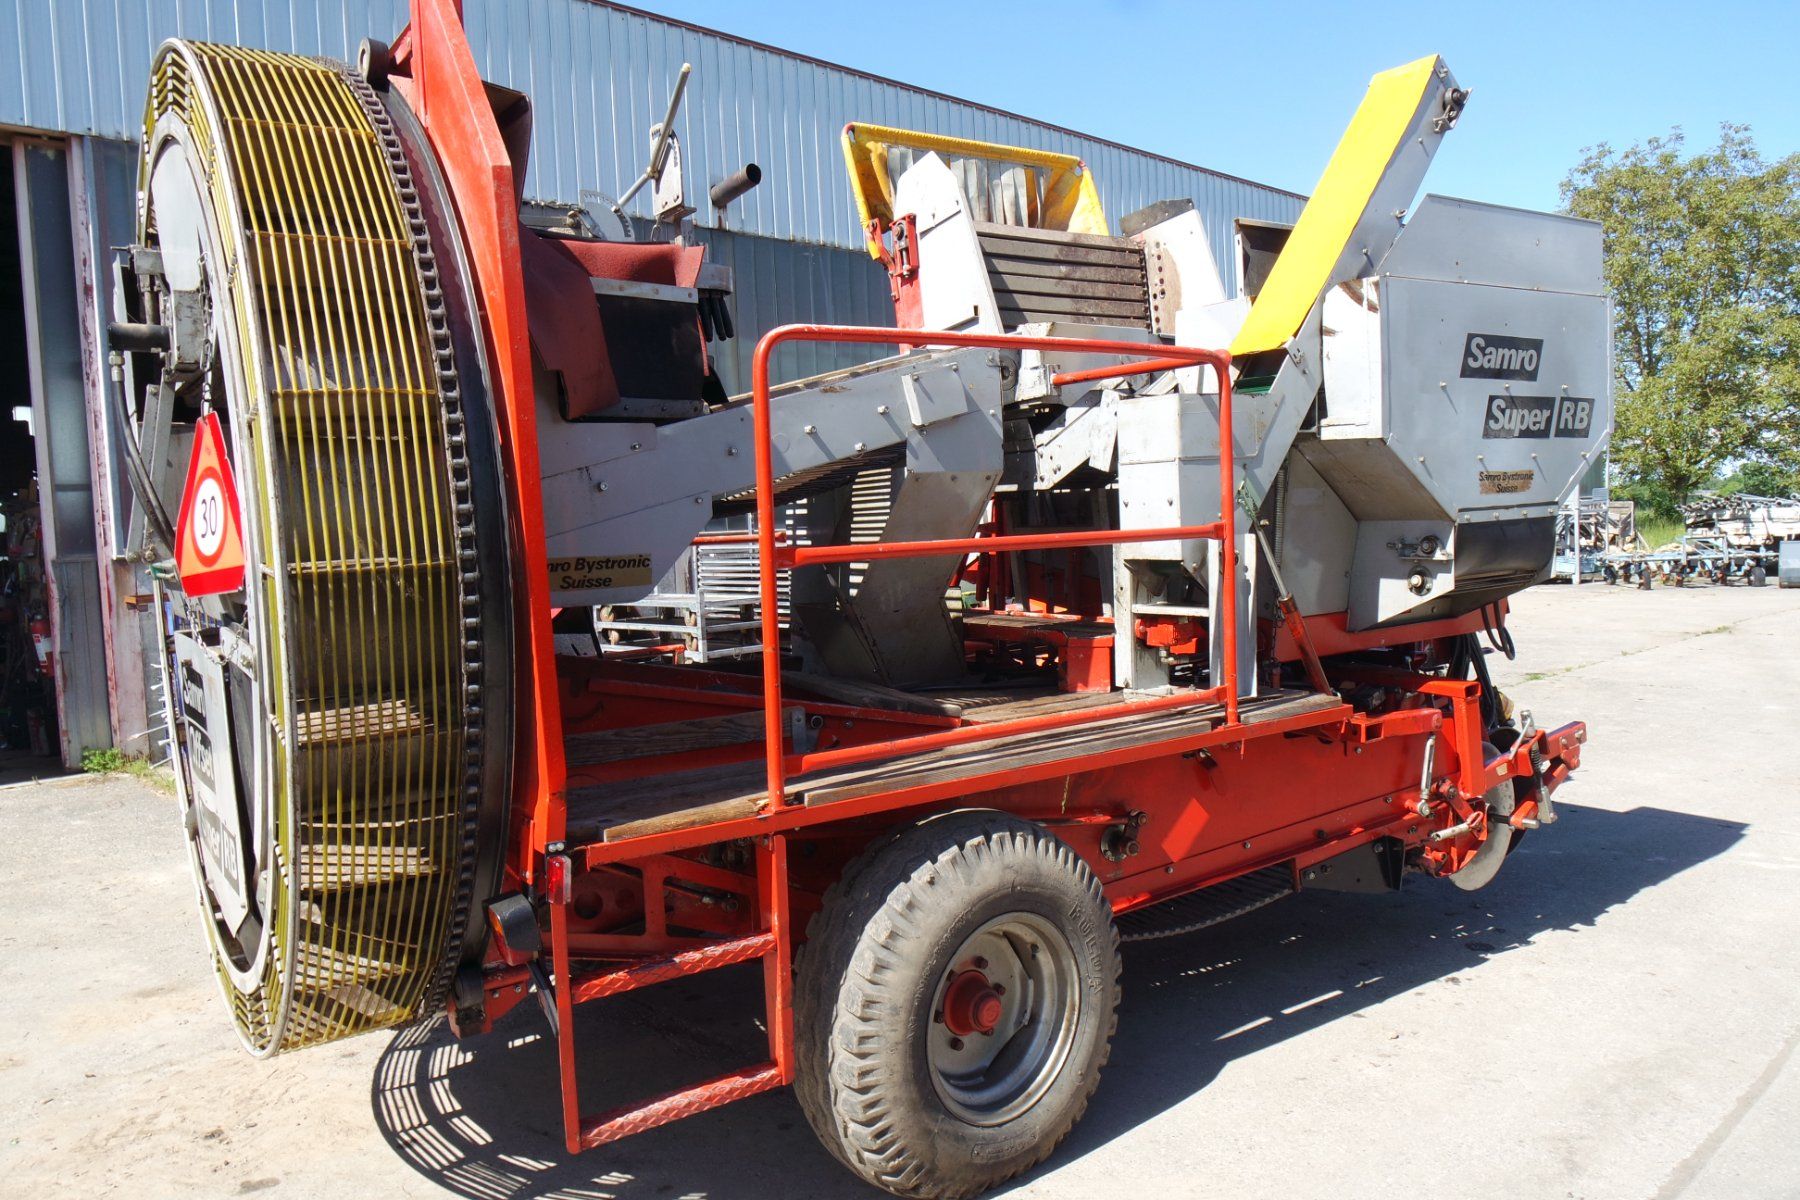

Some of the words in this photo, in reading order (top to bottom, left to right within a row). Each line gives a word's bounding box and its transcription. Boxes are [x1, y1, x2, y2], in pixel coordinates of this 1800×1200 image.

[1467, 336, 1539, 371] Samro
[1488, 398, 1551, 437] Super
[1559, 400, 1590, 430] RB
[1479, 471, 1501, 482] Samro
[1496, 483, 1519, 494] Suisse
[201, 496, 217, 538] 30
[574, 555, 651, 573] Bystronic
[560, 575, 613, 590] Suisse
[223, 830, 238, 880] RB
